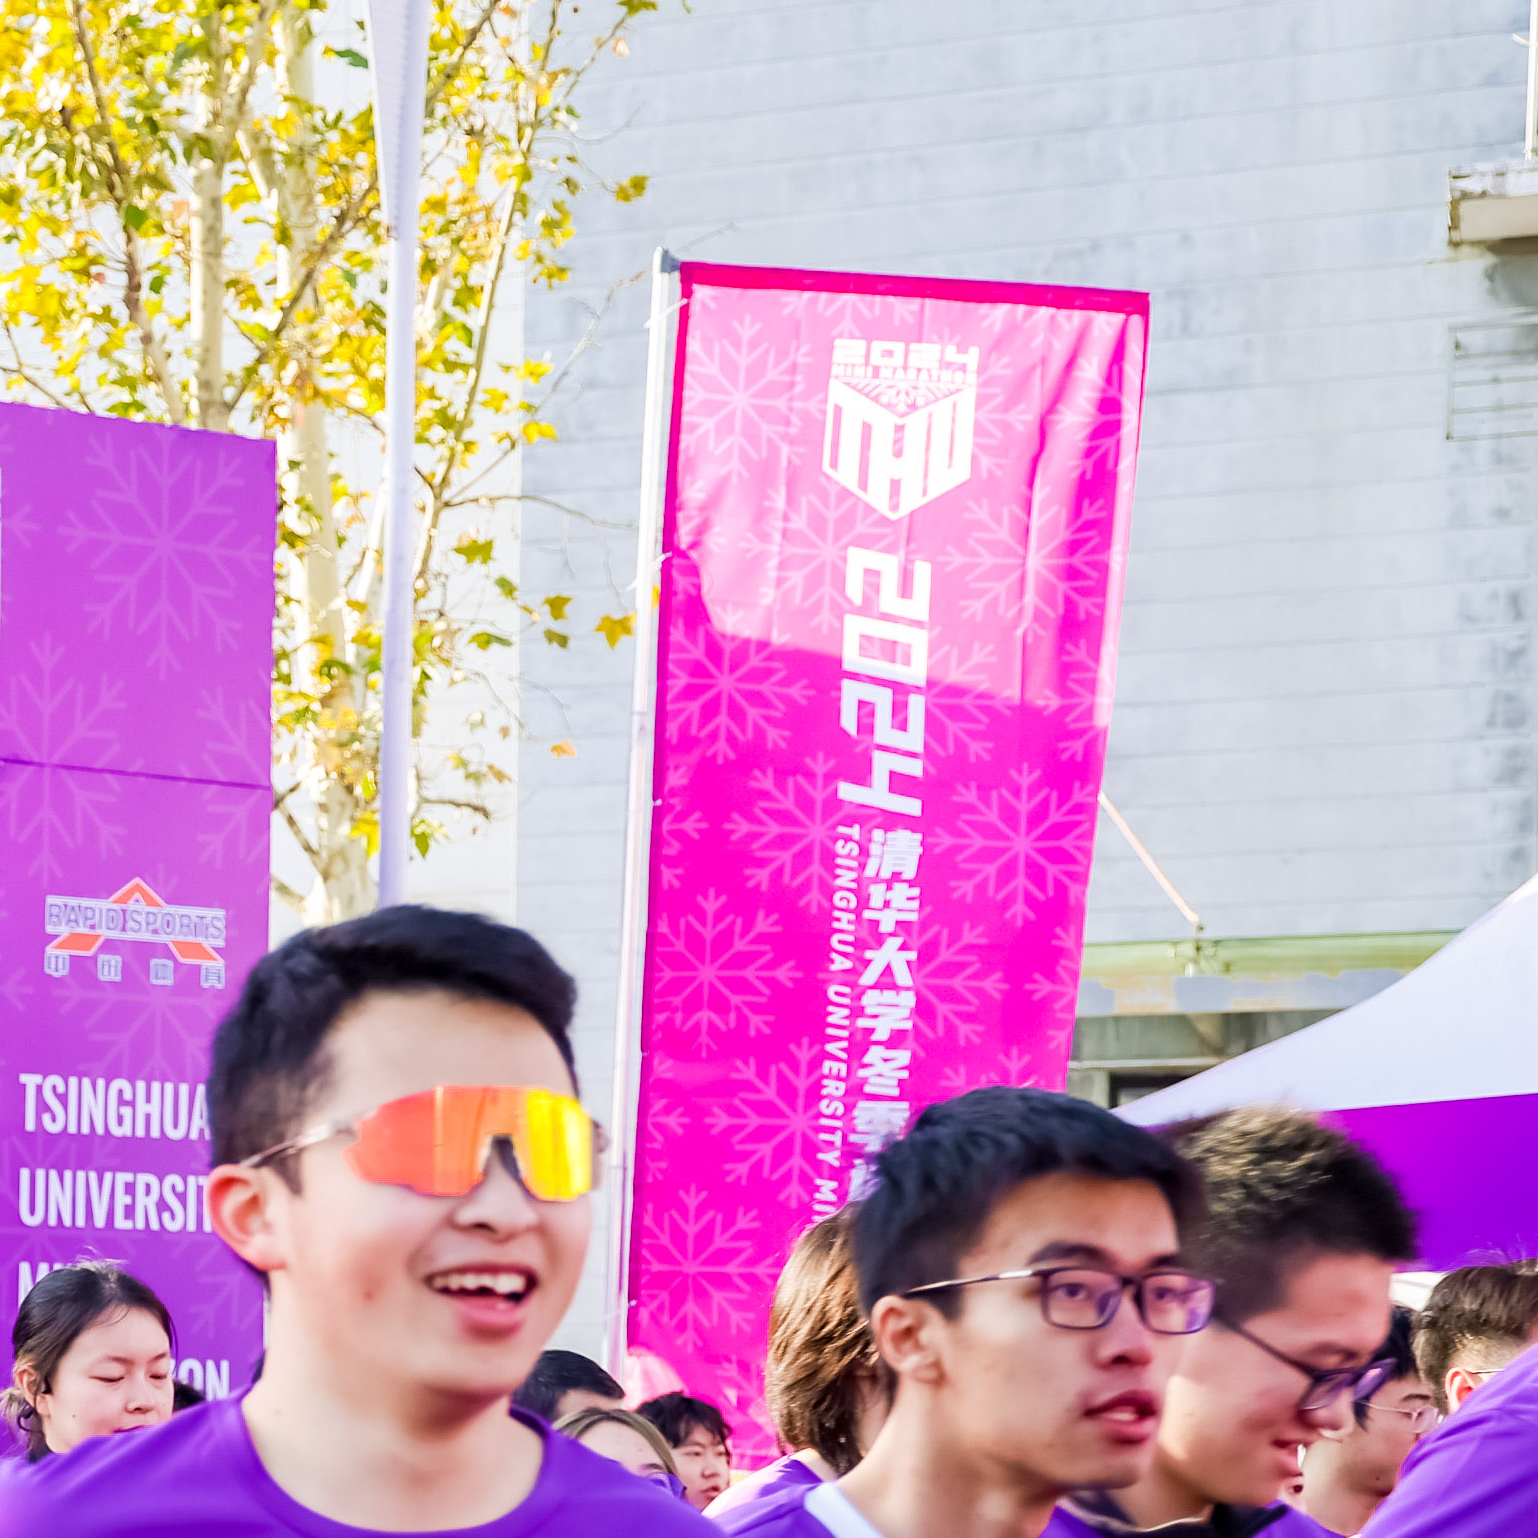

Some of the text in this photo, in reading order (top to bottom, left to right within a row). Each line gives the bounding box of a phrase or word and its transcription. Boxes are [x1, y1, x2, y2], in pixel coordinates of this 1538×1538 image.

[831, 337, 980, 373] 2024
[836, 545, 932, 818] 2024
[47, 902, 226, 941] RAPID SPORTS
[810, 823, 861, 1224] TSINGHUA UNIVERSITY MI
[846, 827, 924, 1202] 清华大学冬季
[19, 1072, 212, 1141] TSINGHUA
[19, 1167, 213, 1233] UNIVERSIT
